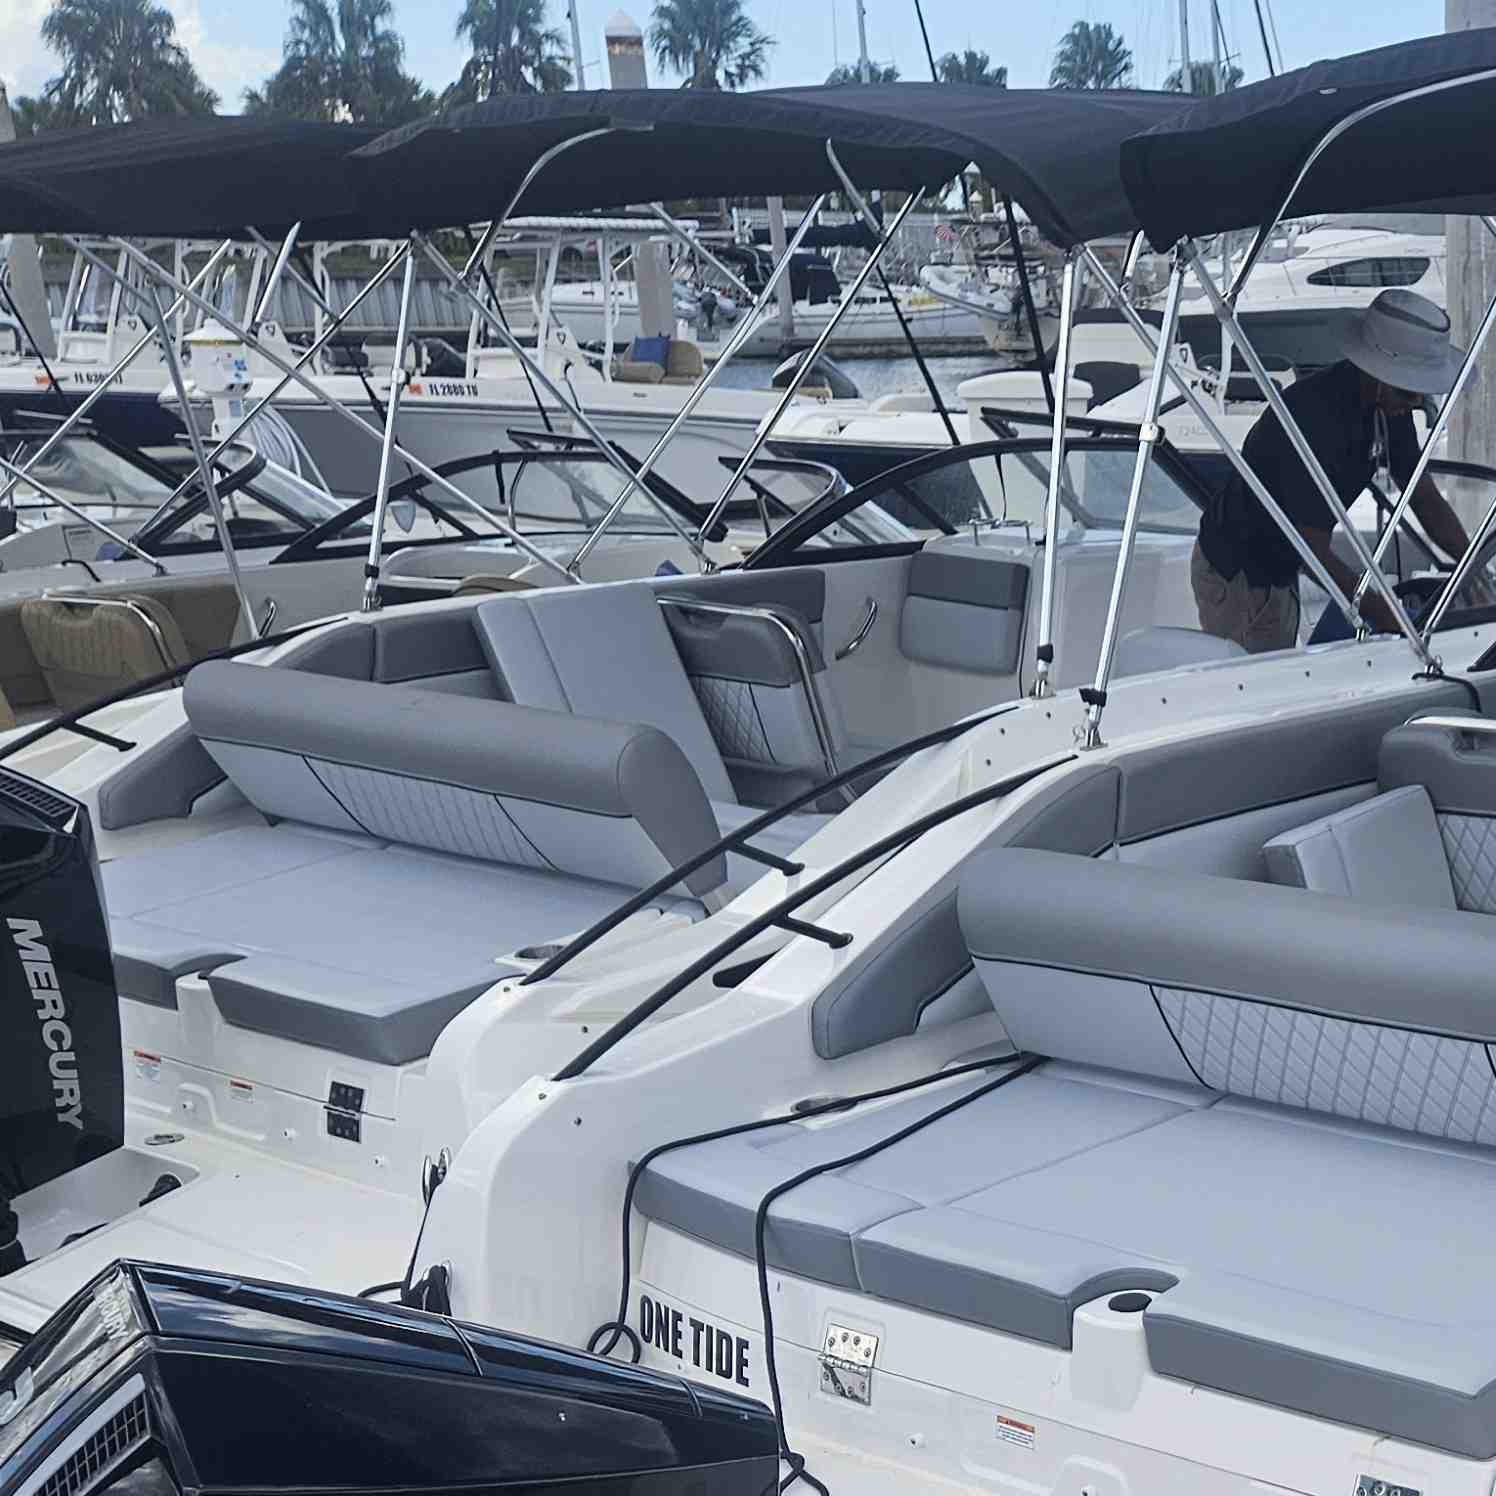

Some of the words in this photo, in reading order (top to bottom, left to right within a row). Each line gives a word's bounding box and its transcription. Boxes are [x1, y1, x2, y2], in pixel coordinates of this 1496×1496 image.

[6, 917, 84, 1131] MERCURY
[640, 1294, 683, 1361] ONE
[688, 1316, 750, 1388] TIDE
